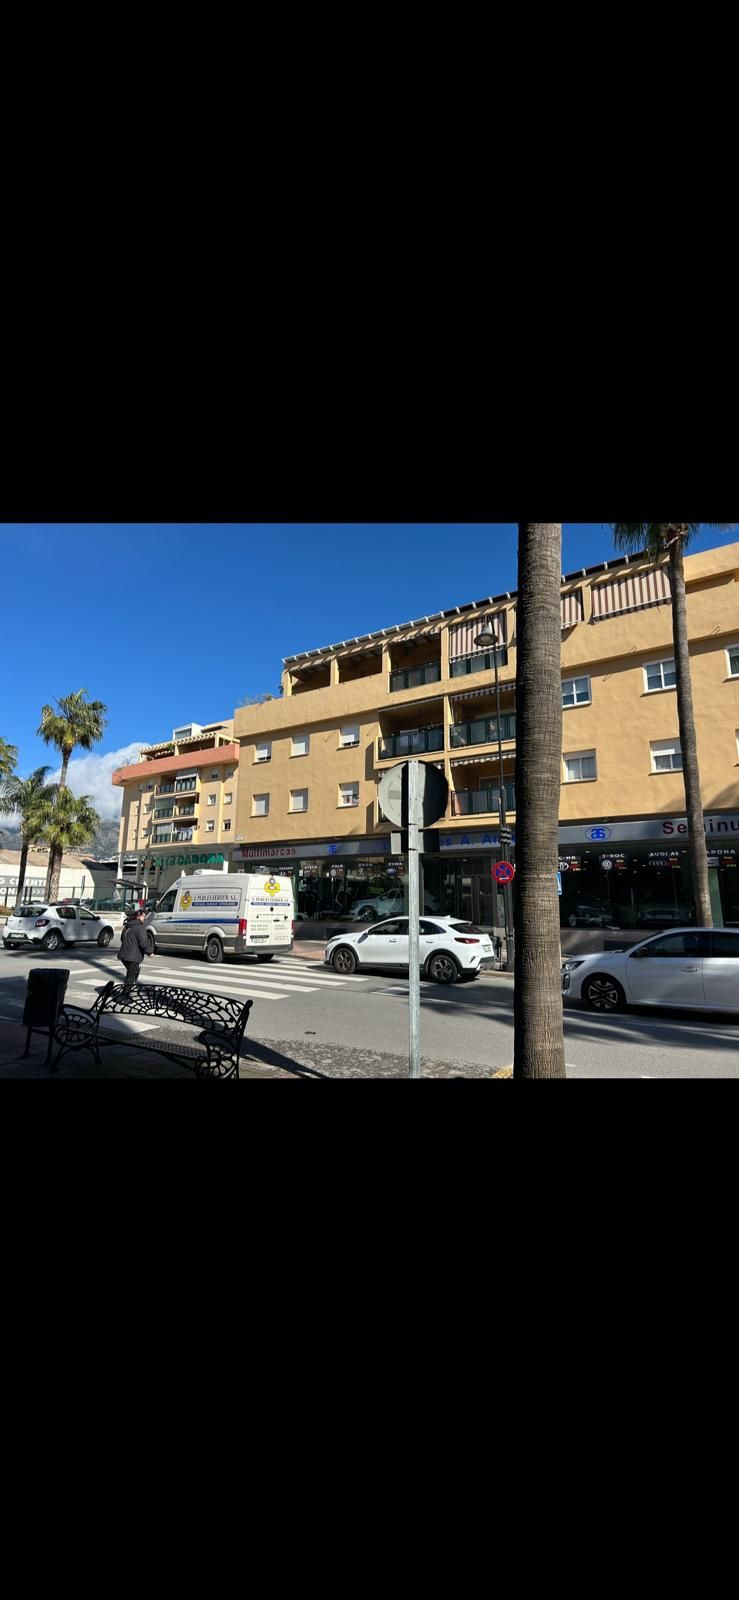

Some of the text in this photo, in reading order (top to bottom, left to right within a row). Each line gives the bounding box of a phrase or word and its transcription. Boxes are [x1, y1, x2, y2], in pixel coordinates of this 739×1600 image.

[662, 819, 739, 834] Seinu
[154, 852, 224, 866] MERCADONA
[242, 847, 297, 858] Multimarcas
